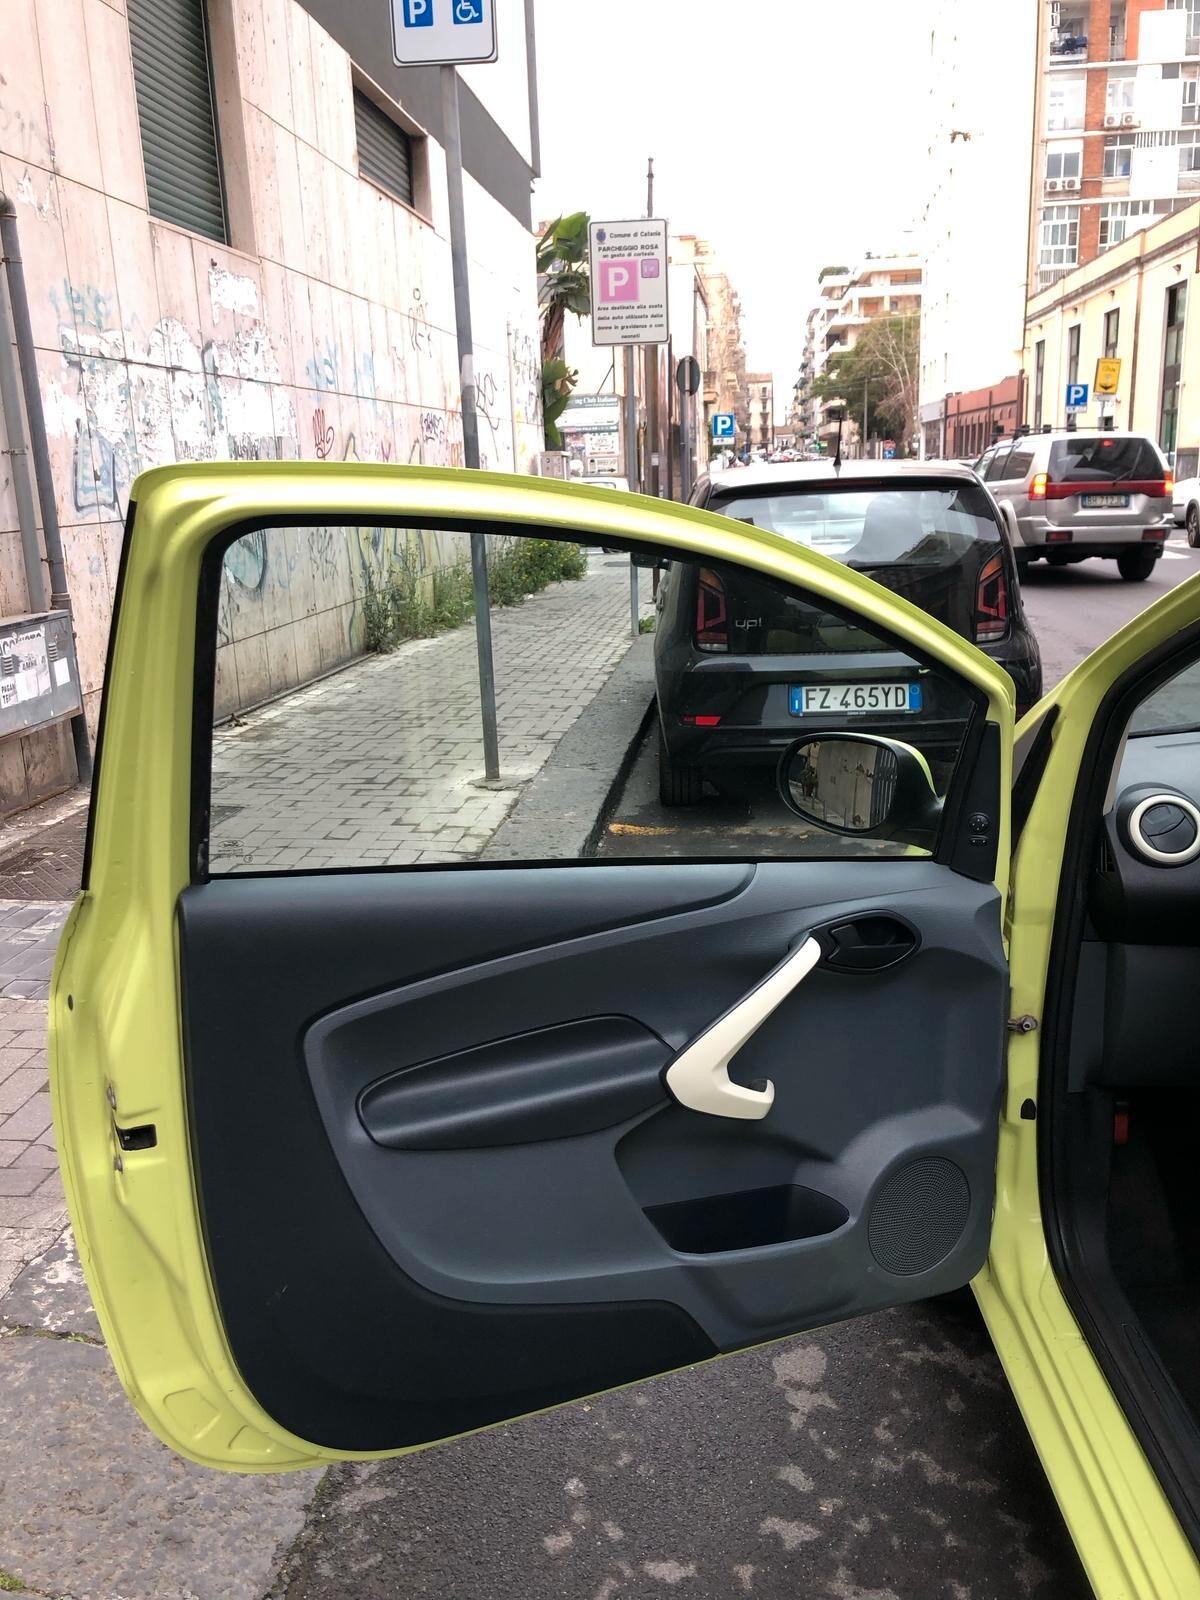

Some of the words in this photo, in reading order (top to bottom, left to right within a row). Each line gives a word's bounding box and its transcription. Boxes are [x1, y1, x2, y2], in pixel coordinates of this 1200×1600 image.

[408, 0, 427, 24] P
[607, 267, 630, 297] P
[1070, 386, 1084, 404] P
[717, 416, 731, 435] P
[735, 617, 762, 631] up!
